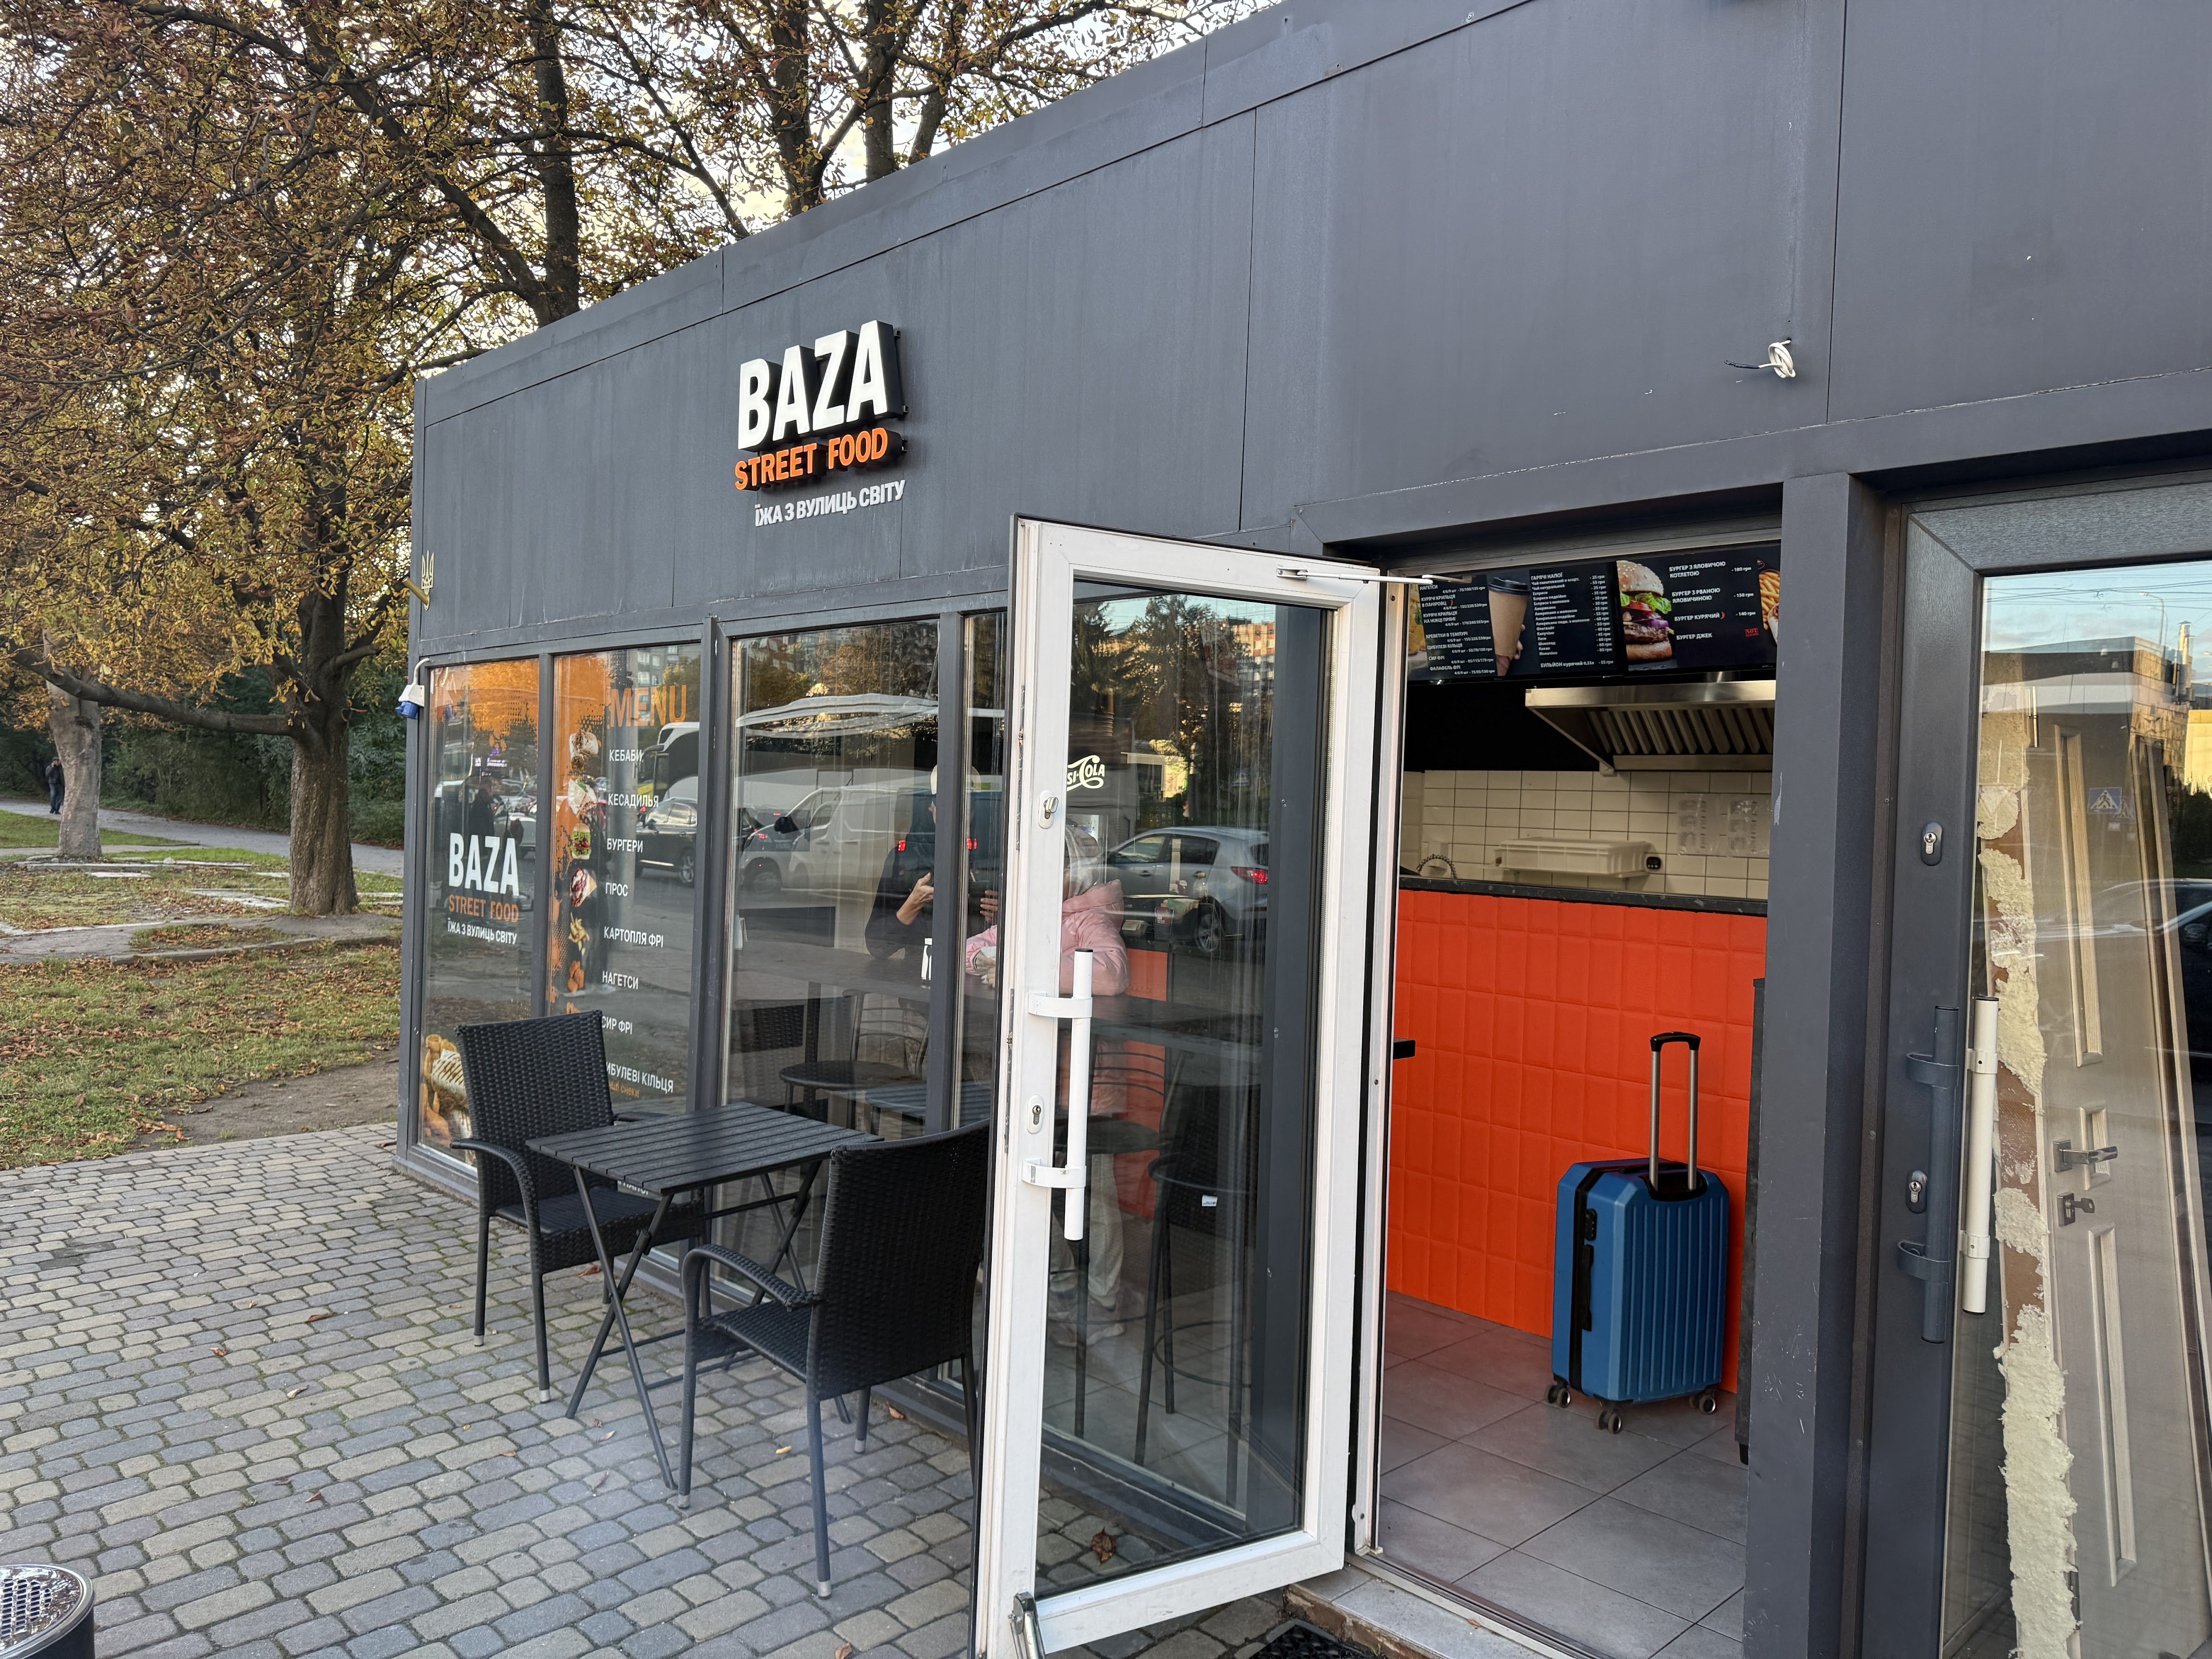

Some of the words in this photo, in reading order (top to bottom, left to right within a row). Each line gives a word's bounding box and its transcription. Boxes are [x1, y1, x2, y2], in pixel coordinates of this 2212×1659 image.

[738, 320, 888, 450] BAZA
[735, 443, 817, 490] STREET
[829, 427, 888, 470] FOOD
[755, 504, 783, 527] ЇЖА
[784, 502, 794, 521] З
[797, 491, 857, 519] ВУЛИЦЬ
[859, 480, 906, 507] СВІТУ
[610, 685, 687, 727] MENU
[609, 750, 643, 762] КЕБАБИ
[1067, 755, 1105, 792] SI-COLA
[608, 793, 659, 809] КЕСАДИЛЬЯ
[606, 838, 643, 853] БУРГЕРИ
[449, 833, 519, 896] BAZA
[605, 882, 628, 897] ГІРОС
[449, 894, 485, 918] STREET
[490, 900, 519, 923] FOOD
[447, 918, 461, 934] ЇЖА
[461, 922, 466, 935] З
[466, 923, 494, 942] ВУЛИЦЬ
[496, 928, 517, 945] СВІТУ
[604, 926, 647, 946] КАРТОПЛЯ
[648, 933, 664, 947] ФРІ
[602, 971, 639, 990] НАГЕТСИ
[601, 1016, 617, 1030] СИР
[618, 1020, 633, 1035] ФРІ
[606, 1062, 640, 1083] ИБУЛЕВІ
[642, 1072, 674, 1094] КІЛЬЦЯ
[621, 1085, 640, 1098] снеки
